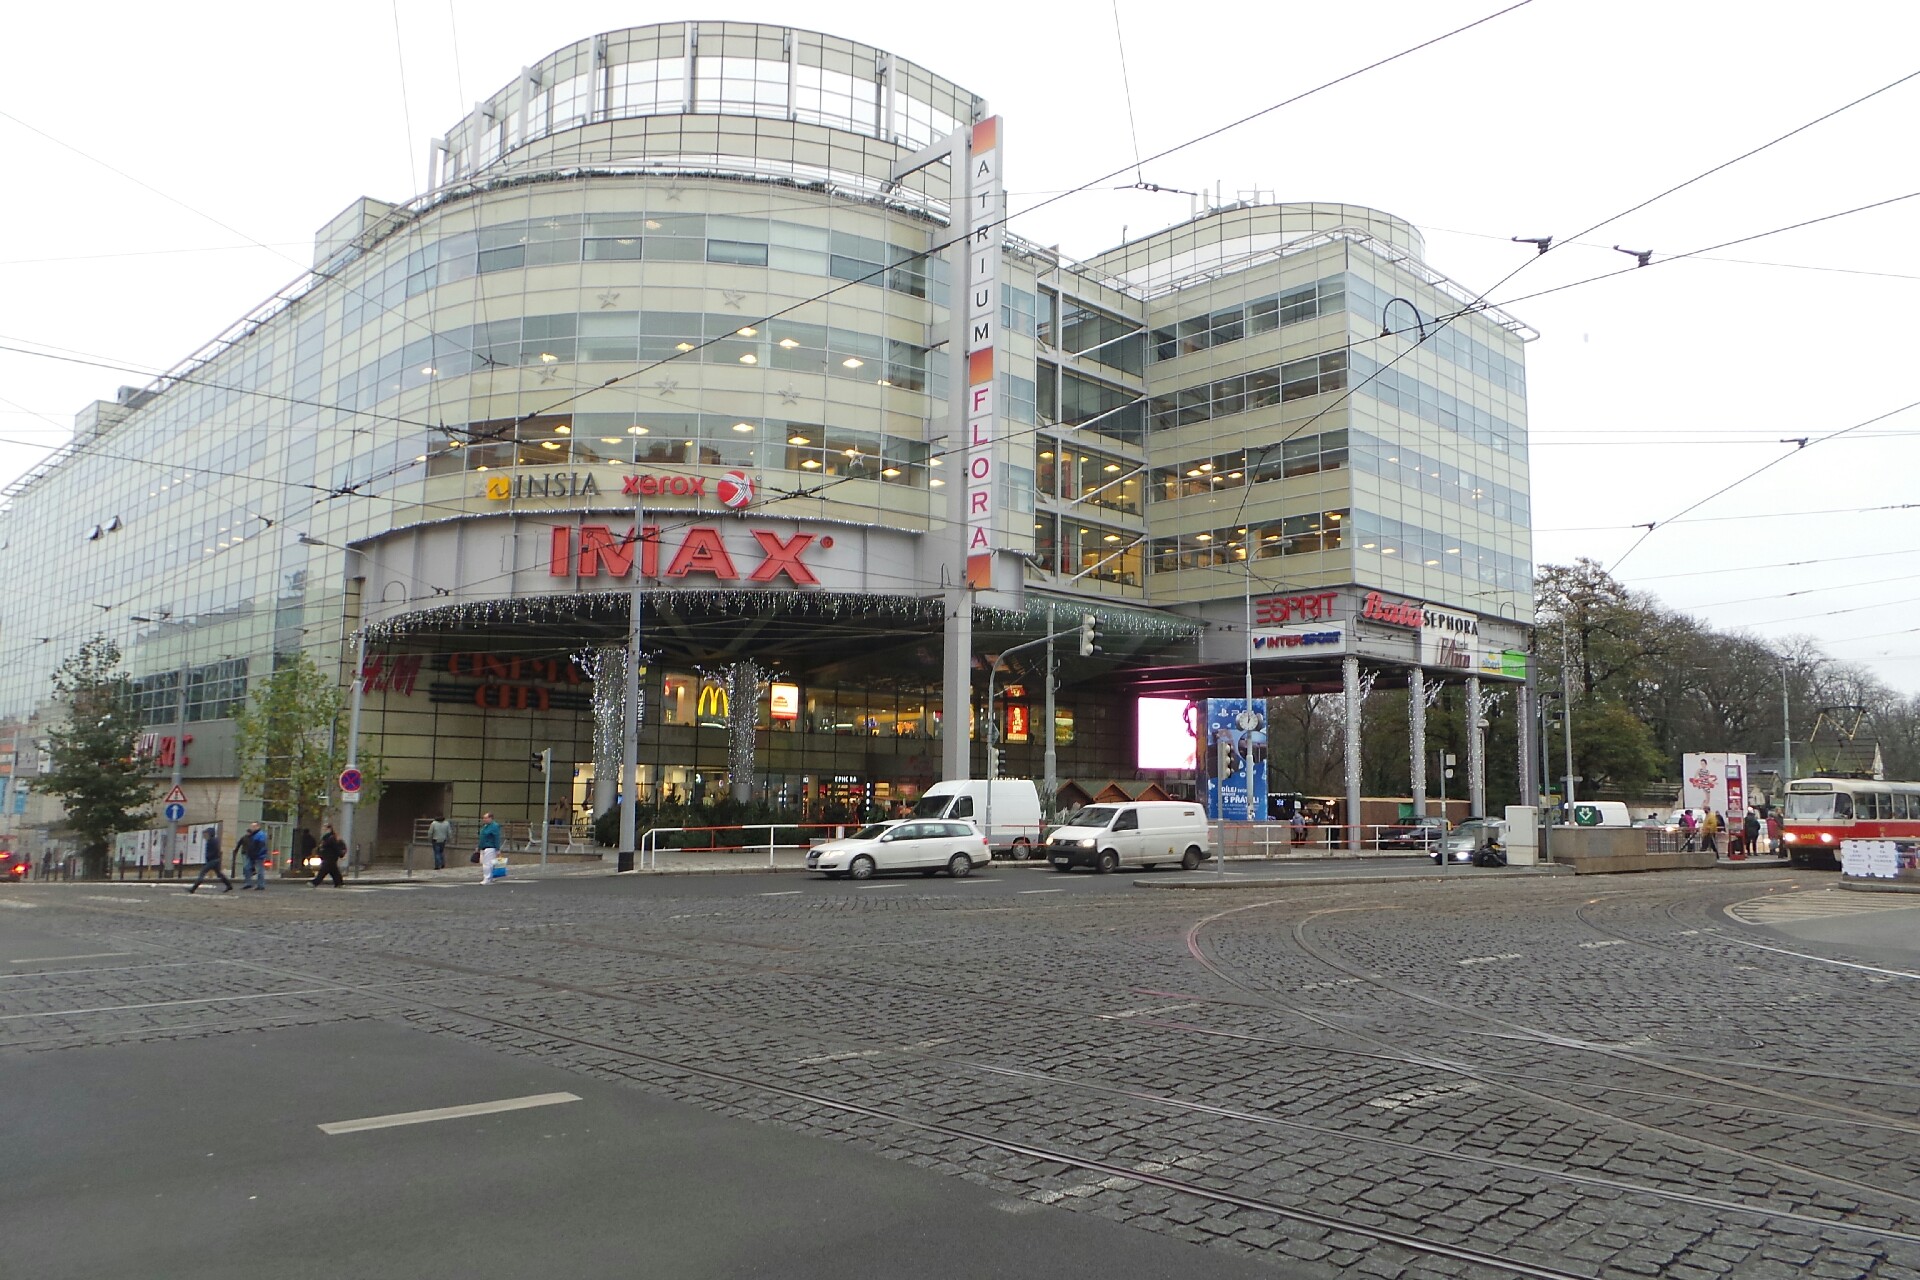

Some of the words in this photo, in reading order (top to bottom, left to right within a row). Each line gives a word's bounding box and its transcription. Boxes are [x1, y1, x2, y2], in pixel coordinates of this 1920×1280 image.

[973, 159, 990, 343] ATRIUM
[970, 387, 990, 550] FLORA
[514, 472, 601, 499] INSIA
[621, 474, 706, 497] xerox
[550, 524, 821, 585] IMAX
[1255, 591, 1338, 624] ESPRIT
[1423, 610, 1479, 637] SEPHORA
[1266, 630, 1342, 649] INTERSPORT
[1230, 795, 1259, 804] PŘÁTLI
